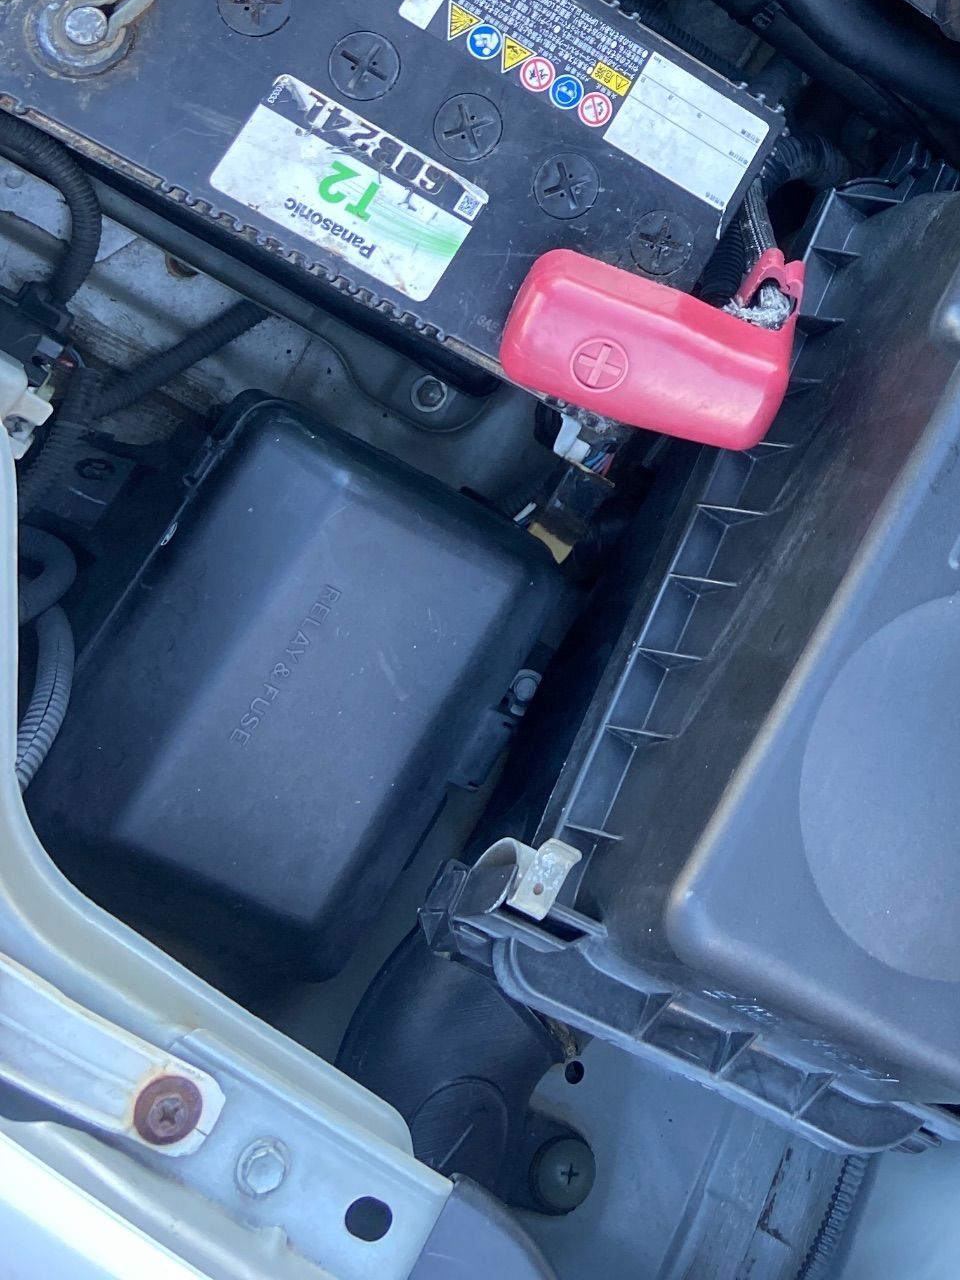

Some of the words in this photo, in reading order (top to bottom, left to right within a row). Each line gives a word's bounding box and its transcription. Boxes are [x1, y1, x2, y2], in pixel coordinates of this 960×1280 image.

[592, 63, 616, 84] 危険
[312, 157, 386, 223] T2
[280, 195, 377, 260] Panasonic
[283, 582, 342, 664] RELAY
[267, 659, 293, 686] &
[228, 681, 280, 747] FUSE
